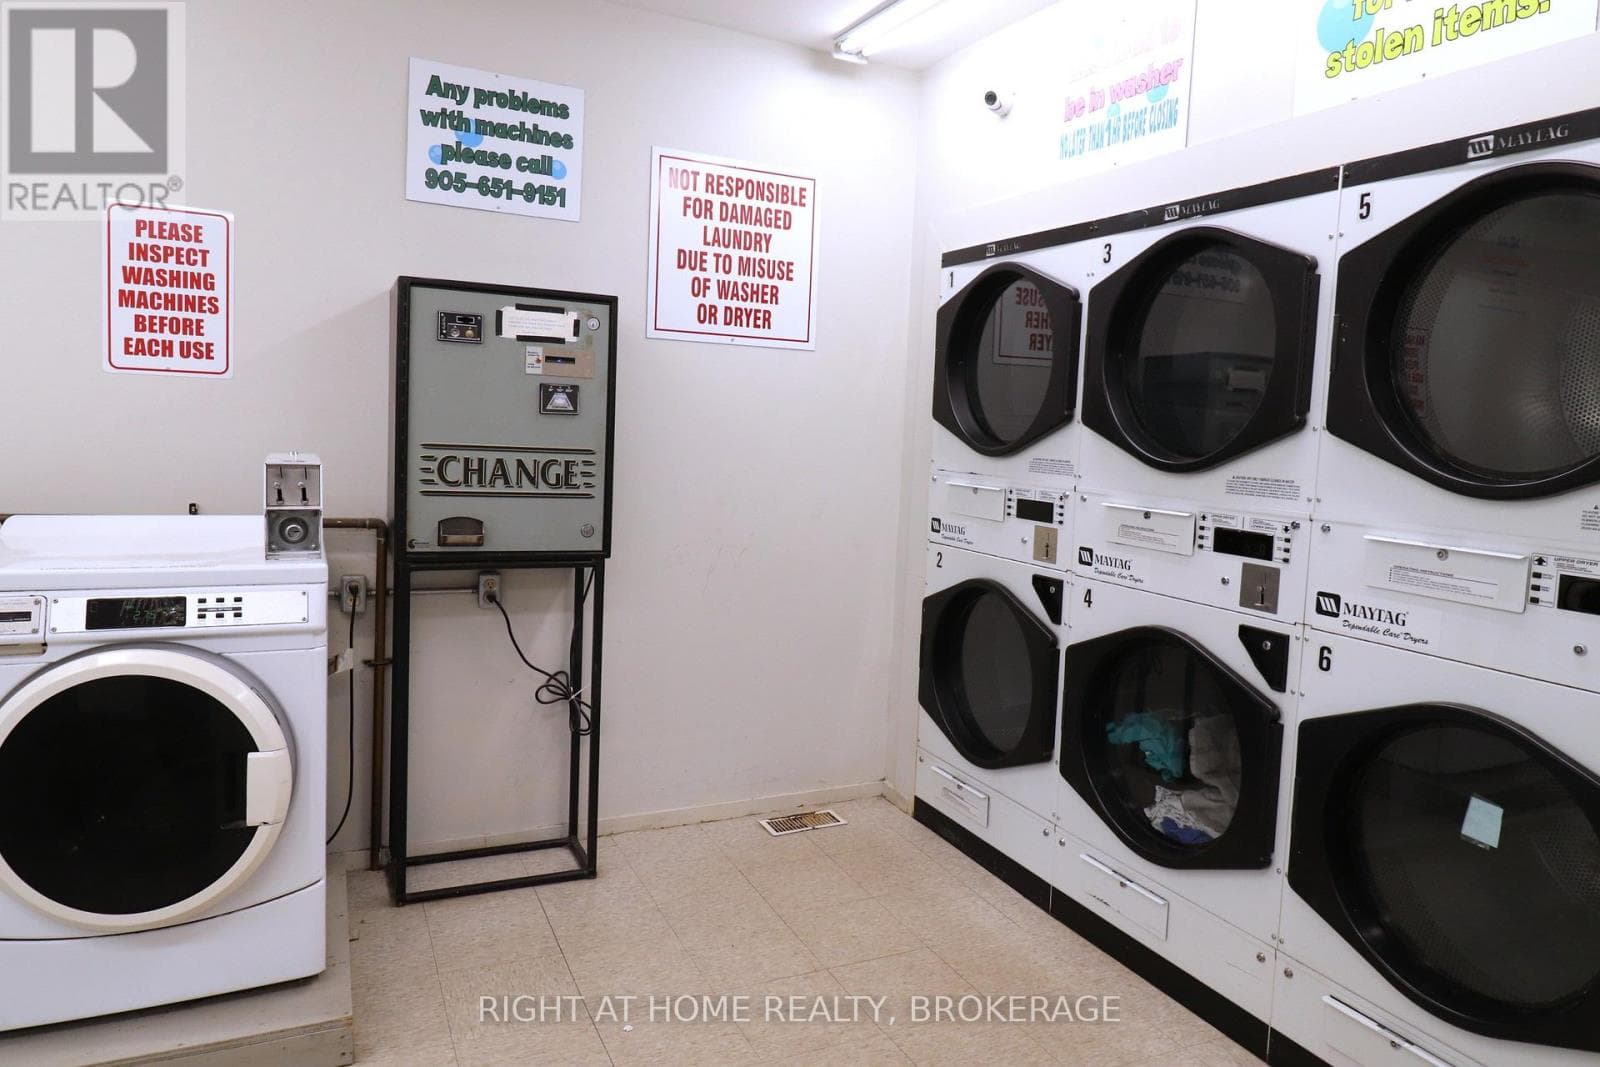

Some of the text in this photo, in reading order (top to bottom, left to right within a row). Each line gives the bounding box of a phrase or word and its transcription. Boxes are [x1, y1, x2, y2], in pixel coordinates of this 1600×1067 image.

[1325, 23, 1425, 79] stolen
[425, 74, 570, 120] Any problems
[1064, 58, 1184, 122] be in washer
[420, 107, 574, 150] with machines
[1122, 106, 1148, 143] BEFORE
[1150, 97, 1179, 134] CLOSING
[1496, 124, 1569, 149] MAYTAG
[440, 141, 553, 176] please call
[424, 167, 567, 208] 905-651-9151
[668, 167, 807, 207] NOT RESPONSIBLE
[683, 196, 792, 230] FOR DAMAGED
[1359, 192, 1371, 219] 5
[135, 219, 203, 243] PLEASE
[703, 225, 772, 253] LAUNDRY
[128, 242, 210, 267] INSPECT
[677, 248, 794, 281] DUE TO MISUSE
[1103, 243, 1112, 263] 3
[122, 266, 216, 291] WASHING
[691, 276, 779, 305] OF WASHER
[949, 271, 954, 288] 1
[118, 289, 220, 315] MACHINES
[134, 314, 205, 336] BEFORE
[697, 303, 772, 330] OR DRYER
[123, 337, 215, 360] EACH USE
[437, 455, 580, 490] CHANGE
[936, 551, 943, 569] 2
[1094, 554, 1132, 571] MAYTAG
[1083, 588, 1093, 608] 4
[1343, 602, 1408, 627] MAYTAG
[1342, 619, 1429, 645] Dependable Care Dryers
[1318, 645, 1332, 672] 6
